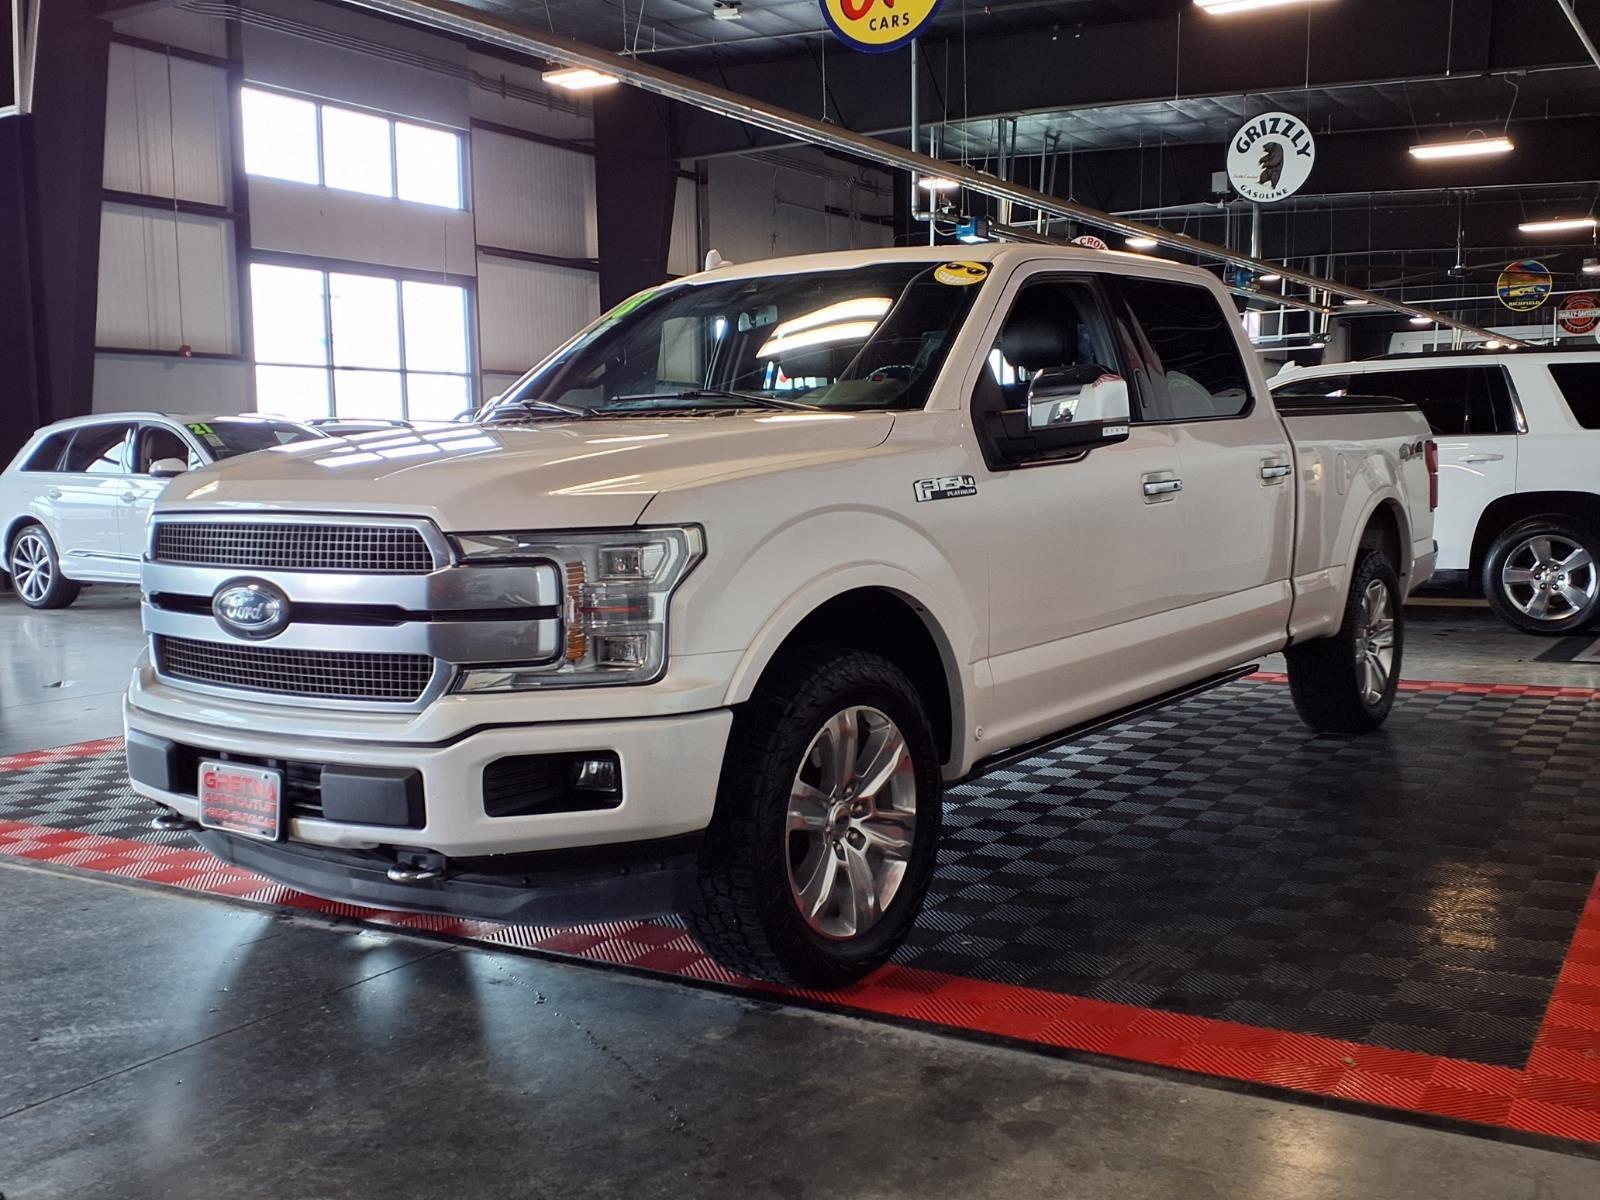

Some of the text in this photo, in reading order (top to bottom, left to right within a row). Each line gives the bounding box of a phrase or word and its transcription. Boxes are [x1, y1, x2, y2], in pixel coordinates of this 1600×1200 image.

[869, 12, 910, 31] CARS
[1236, 117, 1312, 158] GRIZZLY
[1240, 184, 1289, 199] GASOLINE
[947, 488, 976, 496] PLATINUM
[225, 594, 264, 620] Ford
